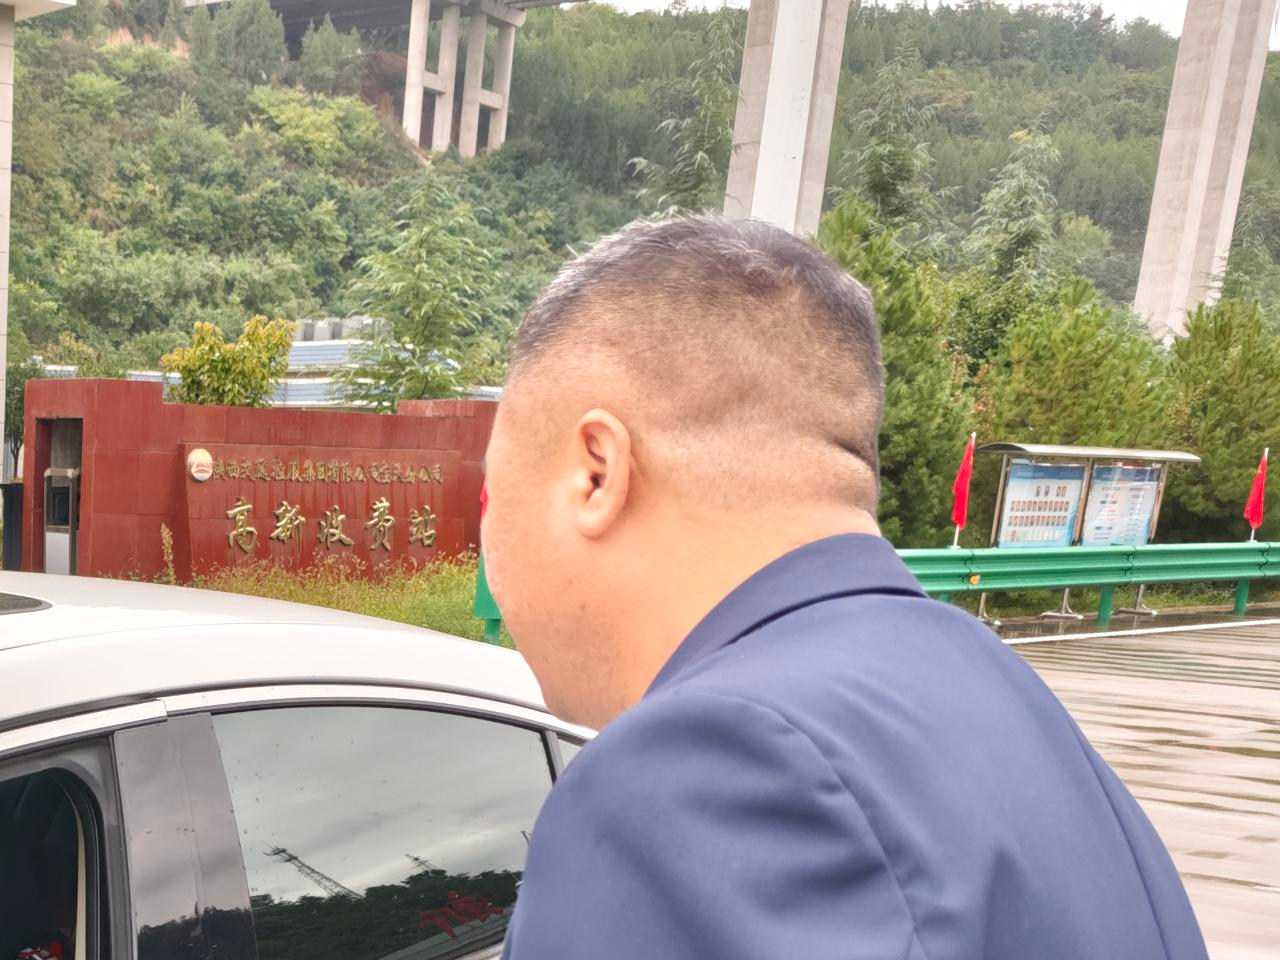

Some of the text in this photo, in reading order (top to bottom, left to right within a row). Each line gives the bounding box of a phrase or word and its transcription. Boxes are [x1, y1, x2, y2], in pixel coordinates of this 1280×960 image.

[225, 496, 437, 553] 高新收费站
